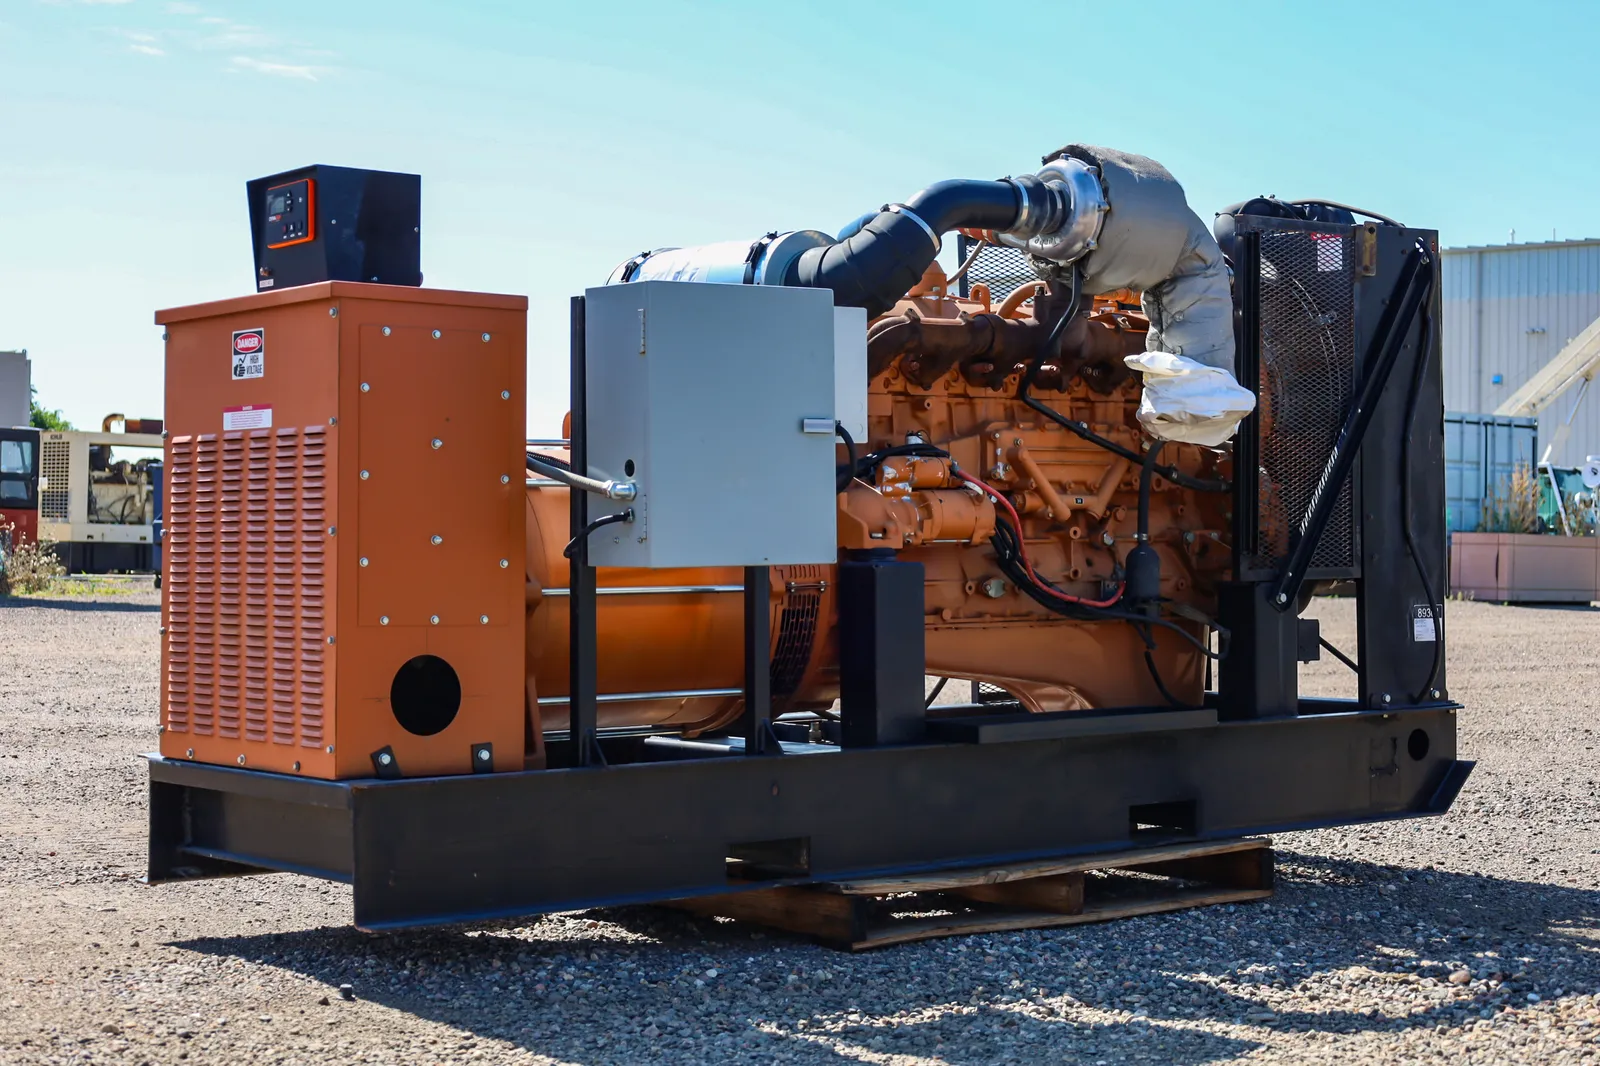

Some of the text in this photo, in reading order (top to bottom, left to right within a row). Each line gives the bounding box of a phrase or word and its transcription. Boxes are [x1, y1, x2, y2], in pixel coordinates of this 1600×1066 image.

[237, 337, 258, 348] DANGER
[250, 355, 259, 364] HIGH
[247, 364, 262, 374] VOLTAGE
[1417, 608, 1438, 617] 893
